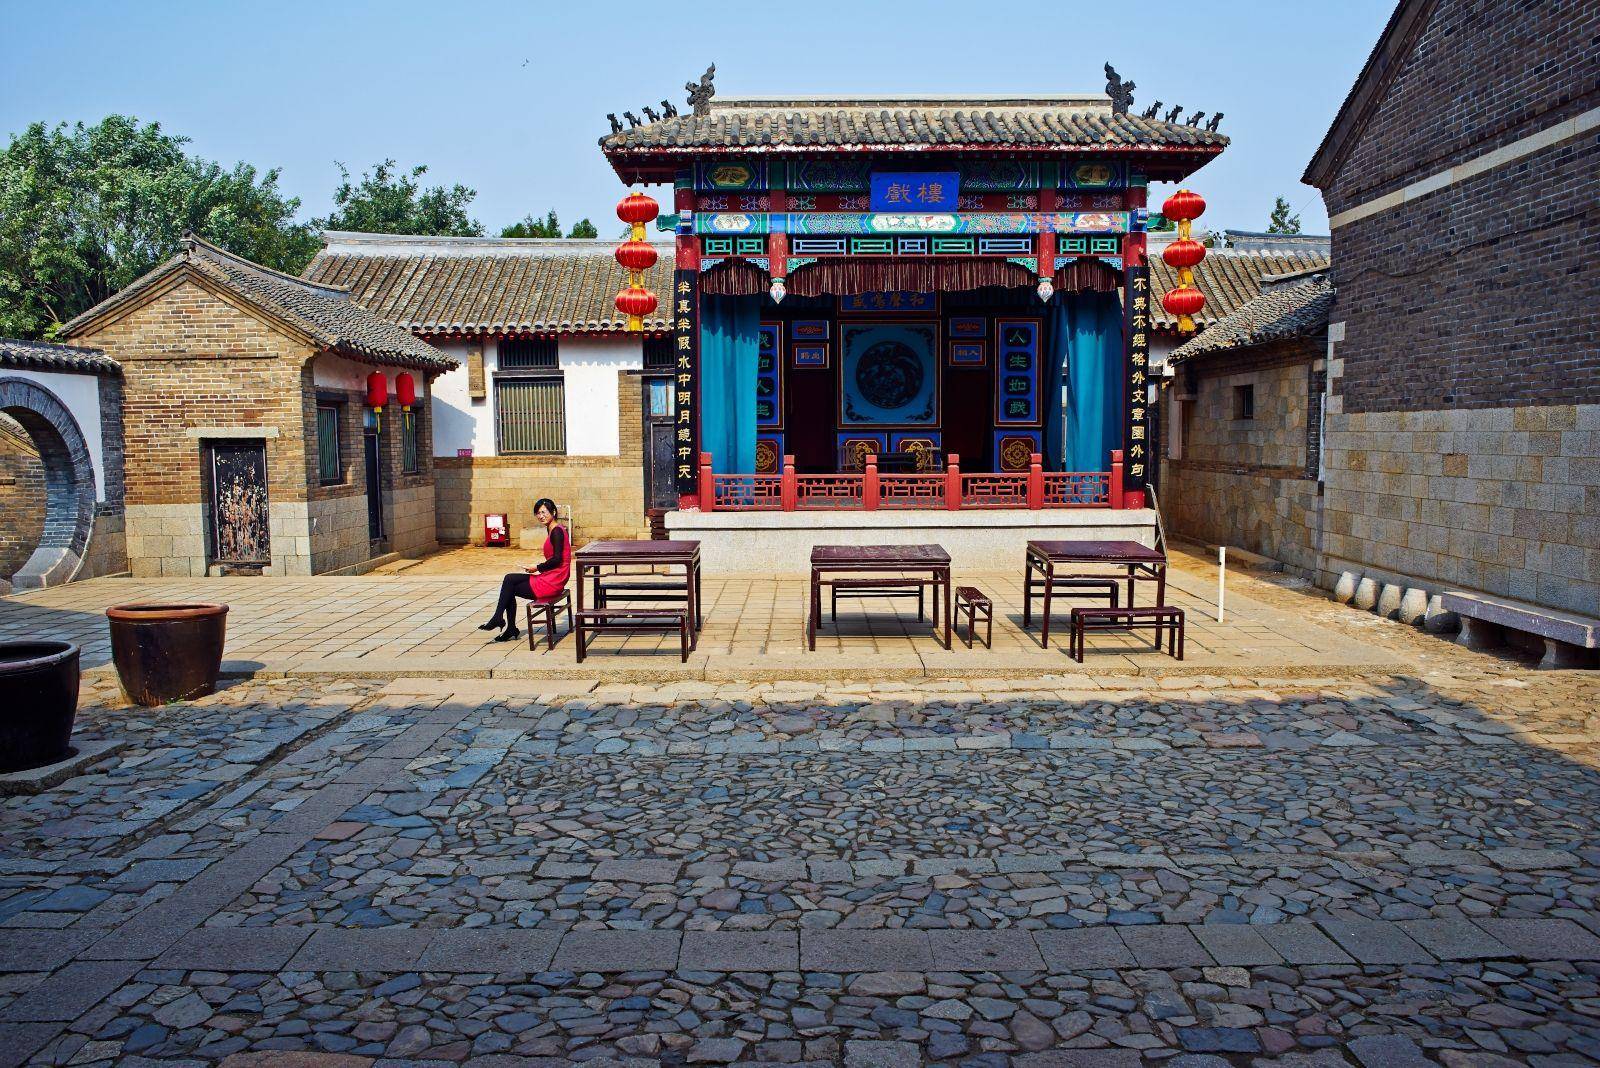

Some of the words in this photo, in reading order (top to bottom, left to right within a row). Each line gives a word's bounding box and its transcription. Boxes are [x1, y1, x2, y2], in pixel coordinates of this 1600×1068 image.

[885, 182, 945, 203] 戲樓
[678, 281, 692, 479] 半真半假水中明月鏡中天
